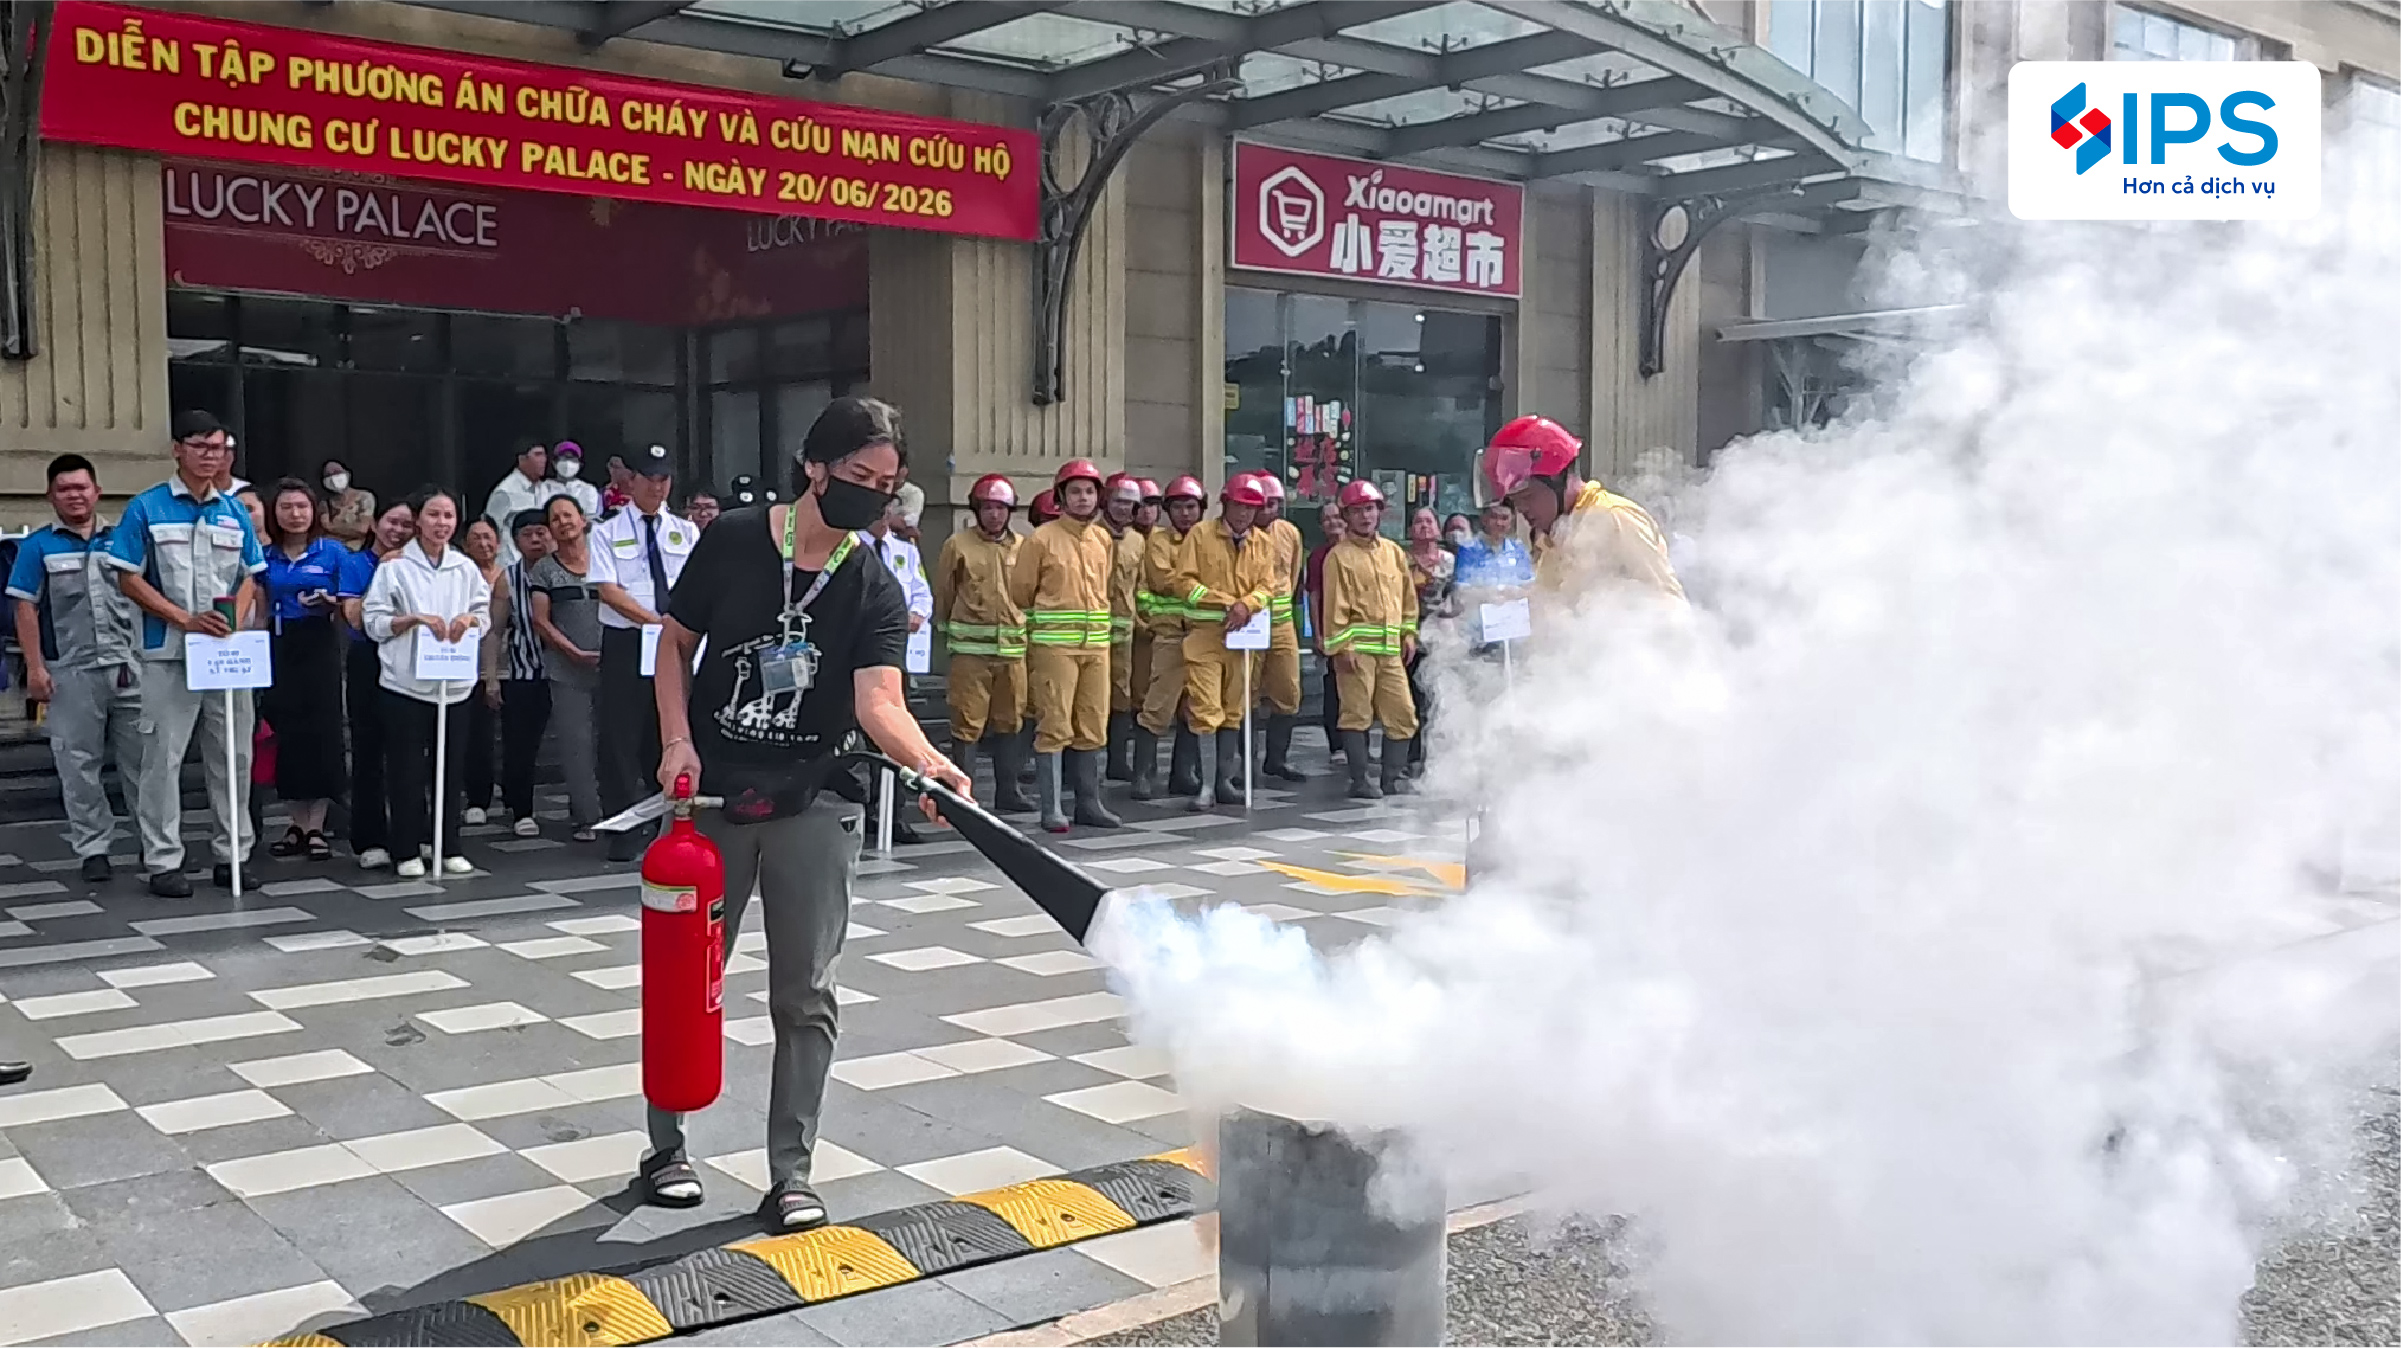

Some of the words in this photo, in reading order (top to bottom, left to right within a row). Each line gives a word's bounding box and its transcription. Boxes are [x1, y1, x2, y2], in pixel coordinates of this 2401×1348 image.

[76, 18, 179, 73] DIỄN
[194, 38, 275, 89] TẬP
[289, 55, 443, 108] PHƯƠNG
[455, 74, 504, 114] ÁN
[517, 84, 610, 127] CHỮA
[622, 99, 706, 138] CHÁY
[719, 107, 759, 145] VÀ
[771, 115, 831, 154] CỨU
[842, 129, 900, 166] NẠN
[909, 133, 965, 171] CỨU
[974, 141, 1011, 182] HỘ
[166, 168, 324, 228] LUCKY
[337, 189, 498, 247] PALACE
[174, 102, 312, 149] CHUNG
[325, 118, 379, 156] CƯ
[390, 127, 507, 170] LUCKY
[522, 142, 650, 186] PALACE
[685, 160, 766, 197] NGÀY
[778, 171, 953, 218] 20/06/2026
[1330, 213, 1504, 287] 小爱超市
